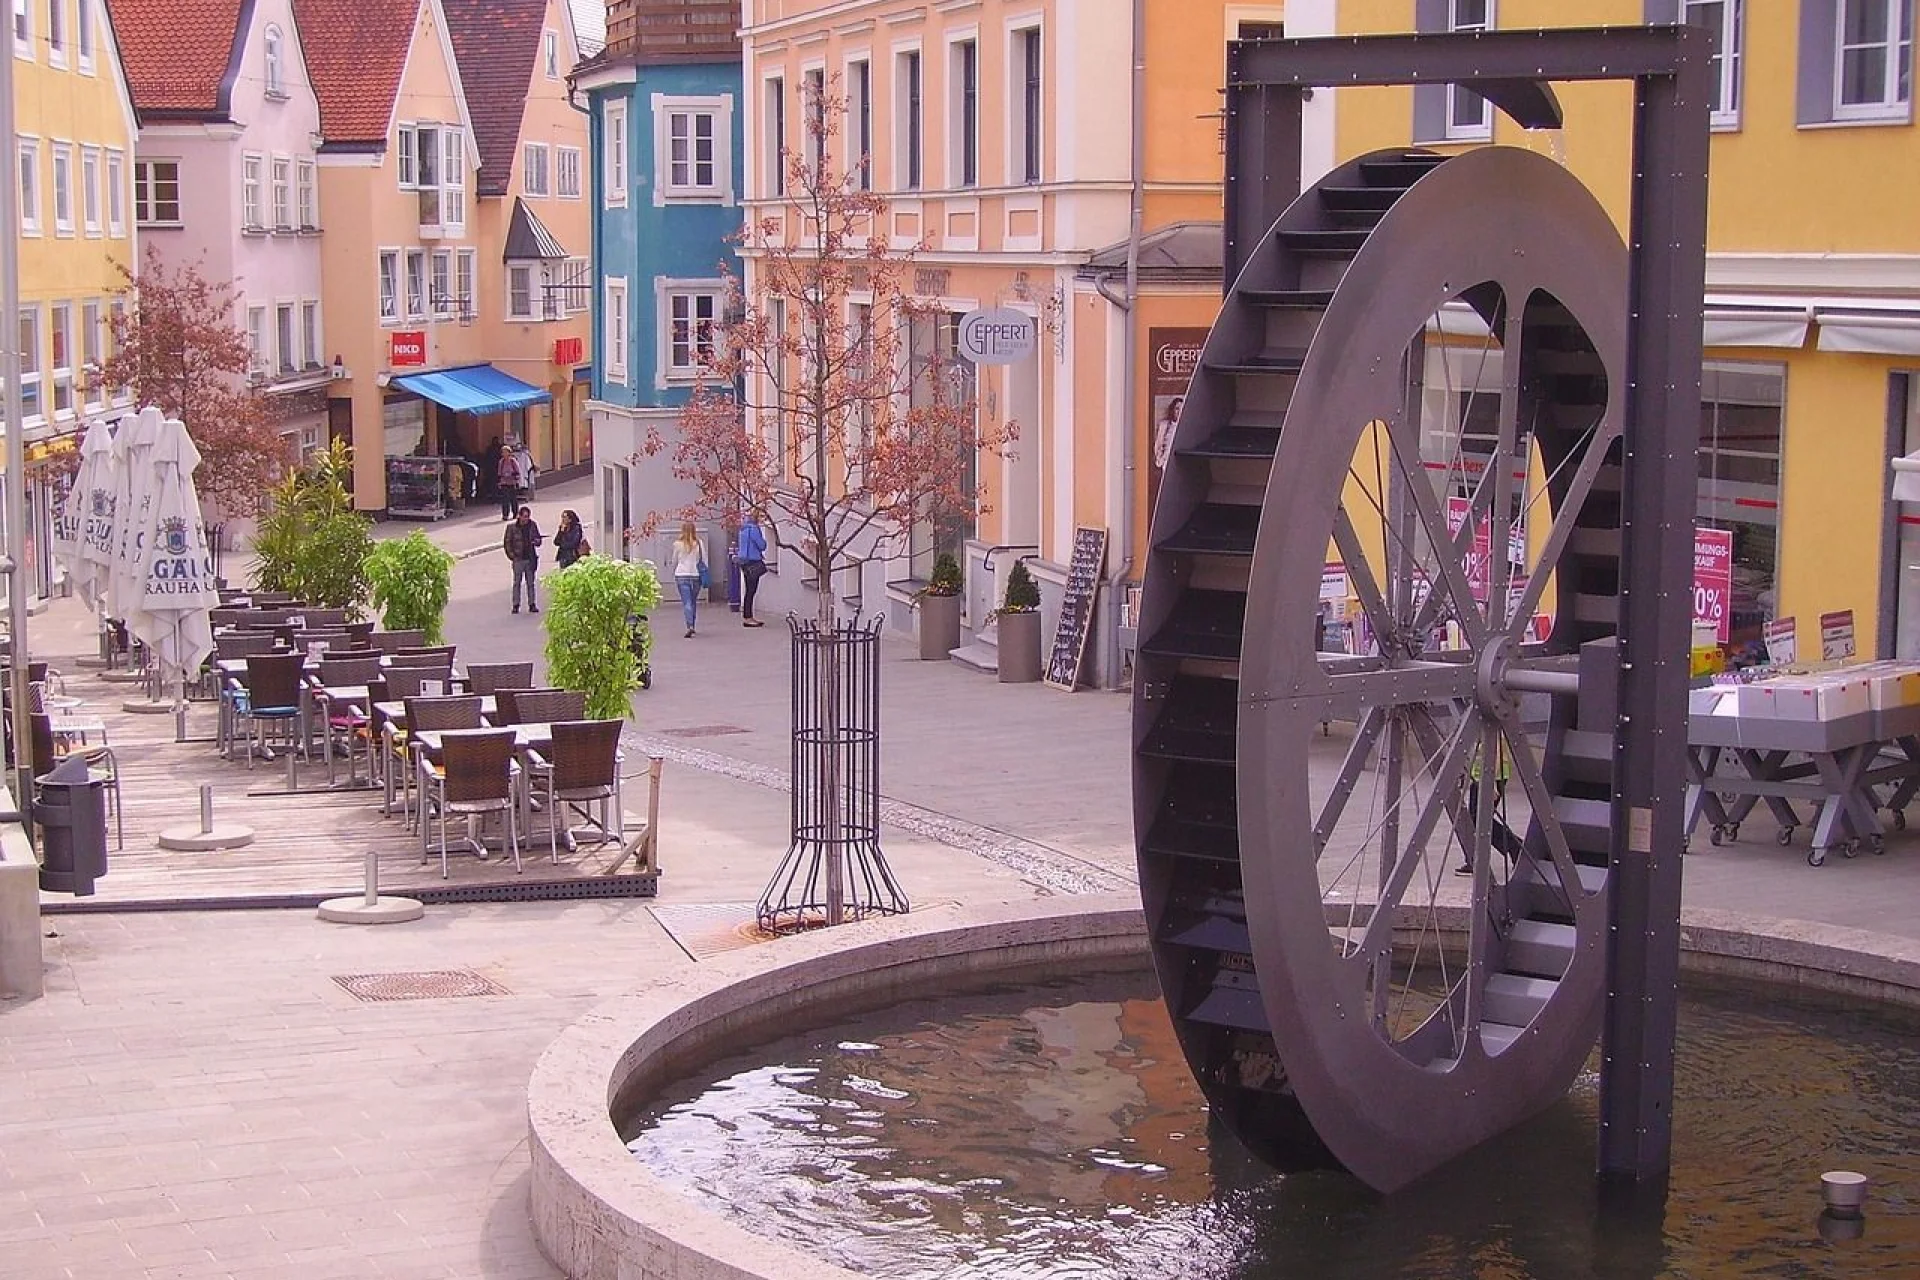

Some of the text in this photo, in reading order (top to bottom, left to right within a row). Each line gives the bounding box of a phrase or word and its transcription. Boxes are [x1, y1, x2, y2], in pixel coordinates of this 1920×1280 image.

[966, 316, 1029, 355] GEPPERT
[394, 344, 421, 354] NKD
[1695, 556, 1716, 568] KAUF
[1692, 587, 1722, 618] 0%
